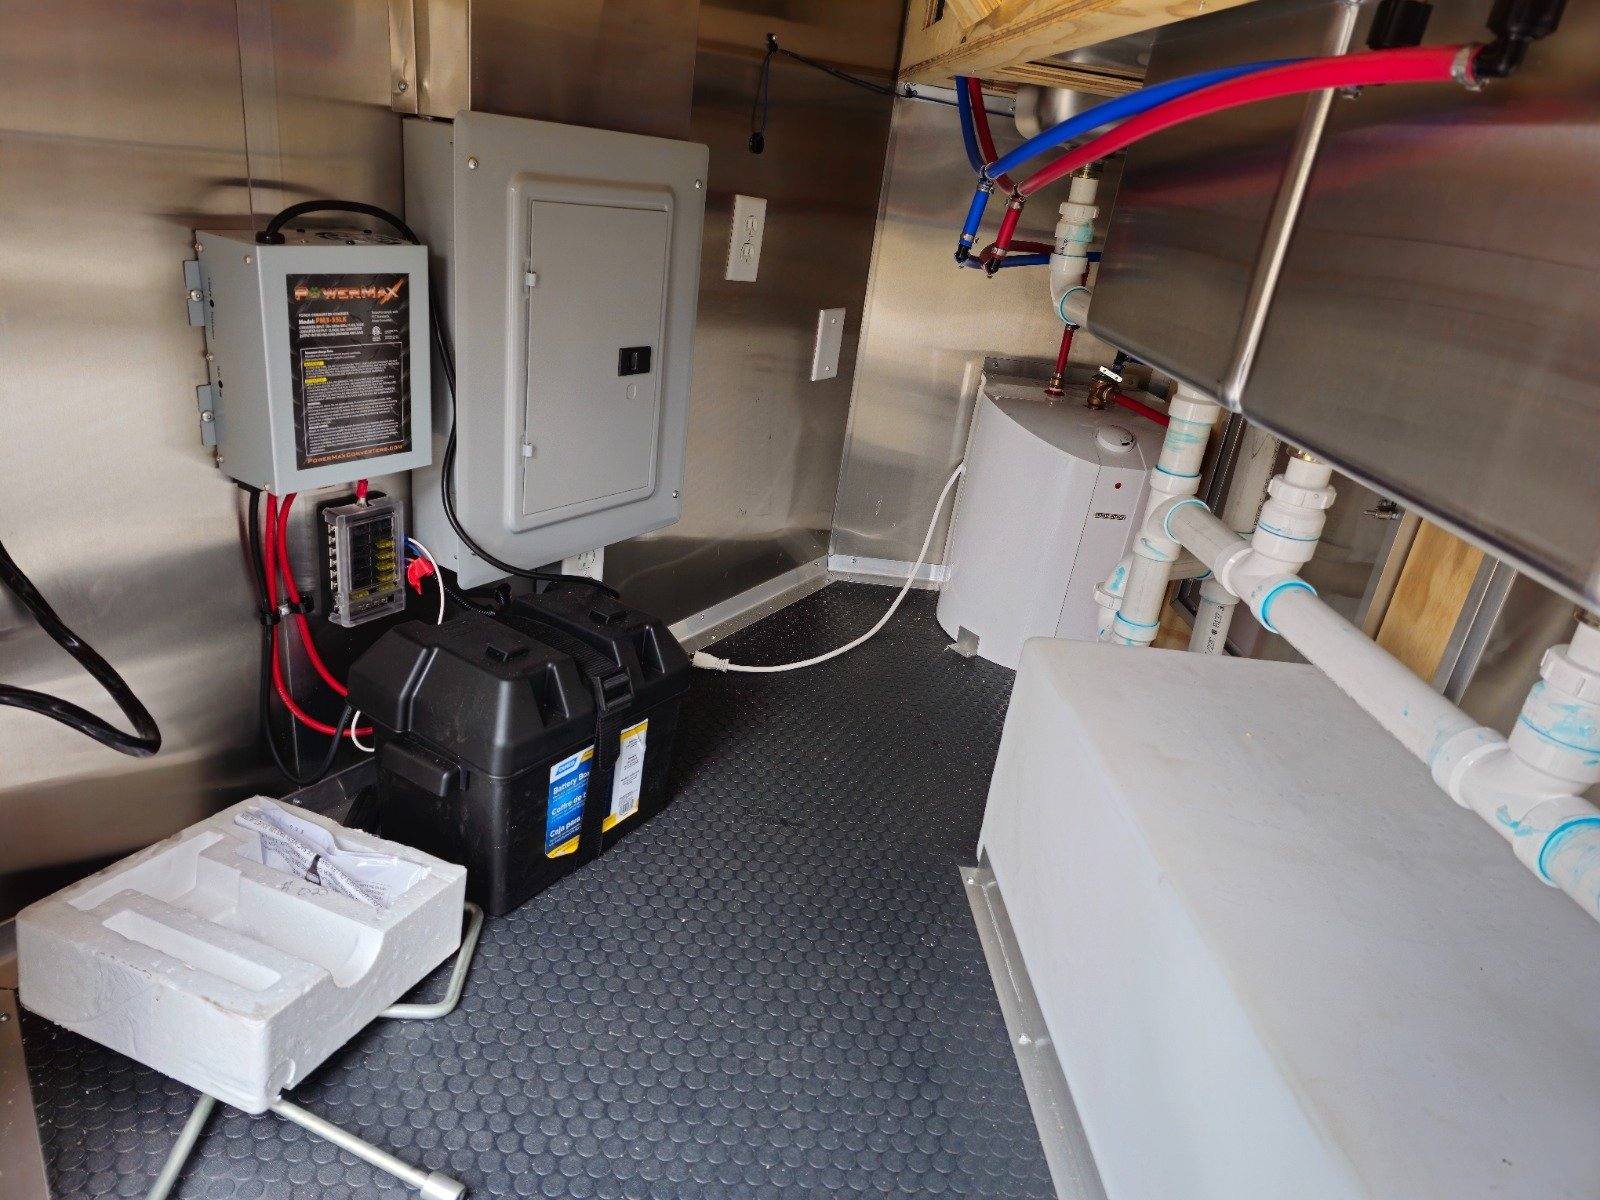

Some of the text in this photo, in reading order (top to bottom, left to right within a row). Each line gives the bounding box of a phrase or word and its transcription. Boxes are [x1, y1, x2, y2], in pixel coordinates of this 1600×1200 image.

[553, 777, 576, 795] Battery
[551, 800, 572, 815] Coffre
[550, 824, 565, 837] Caja
